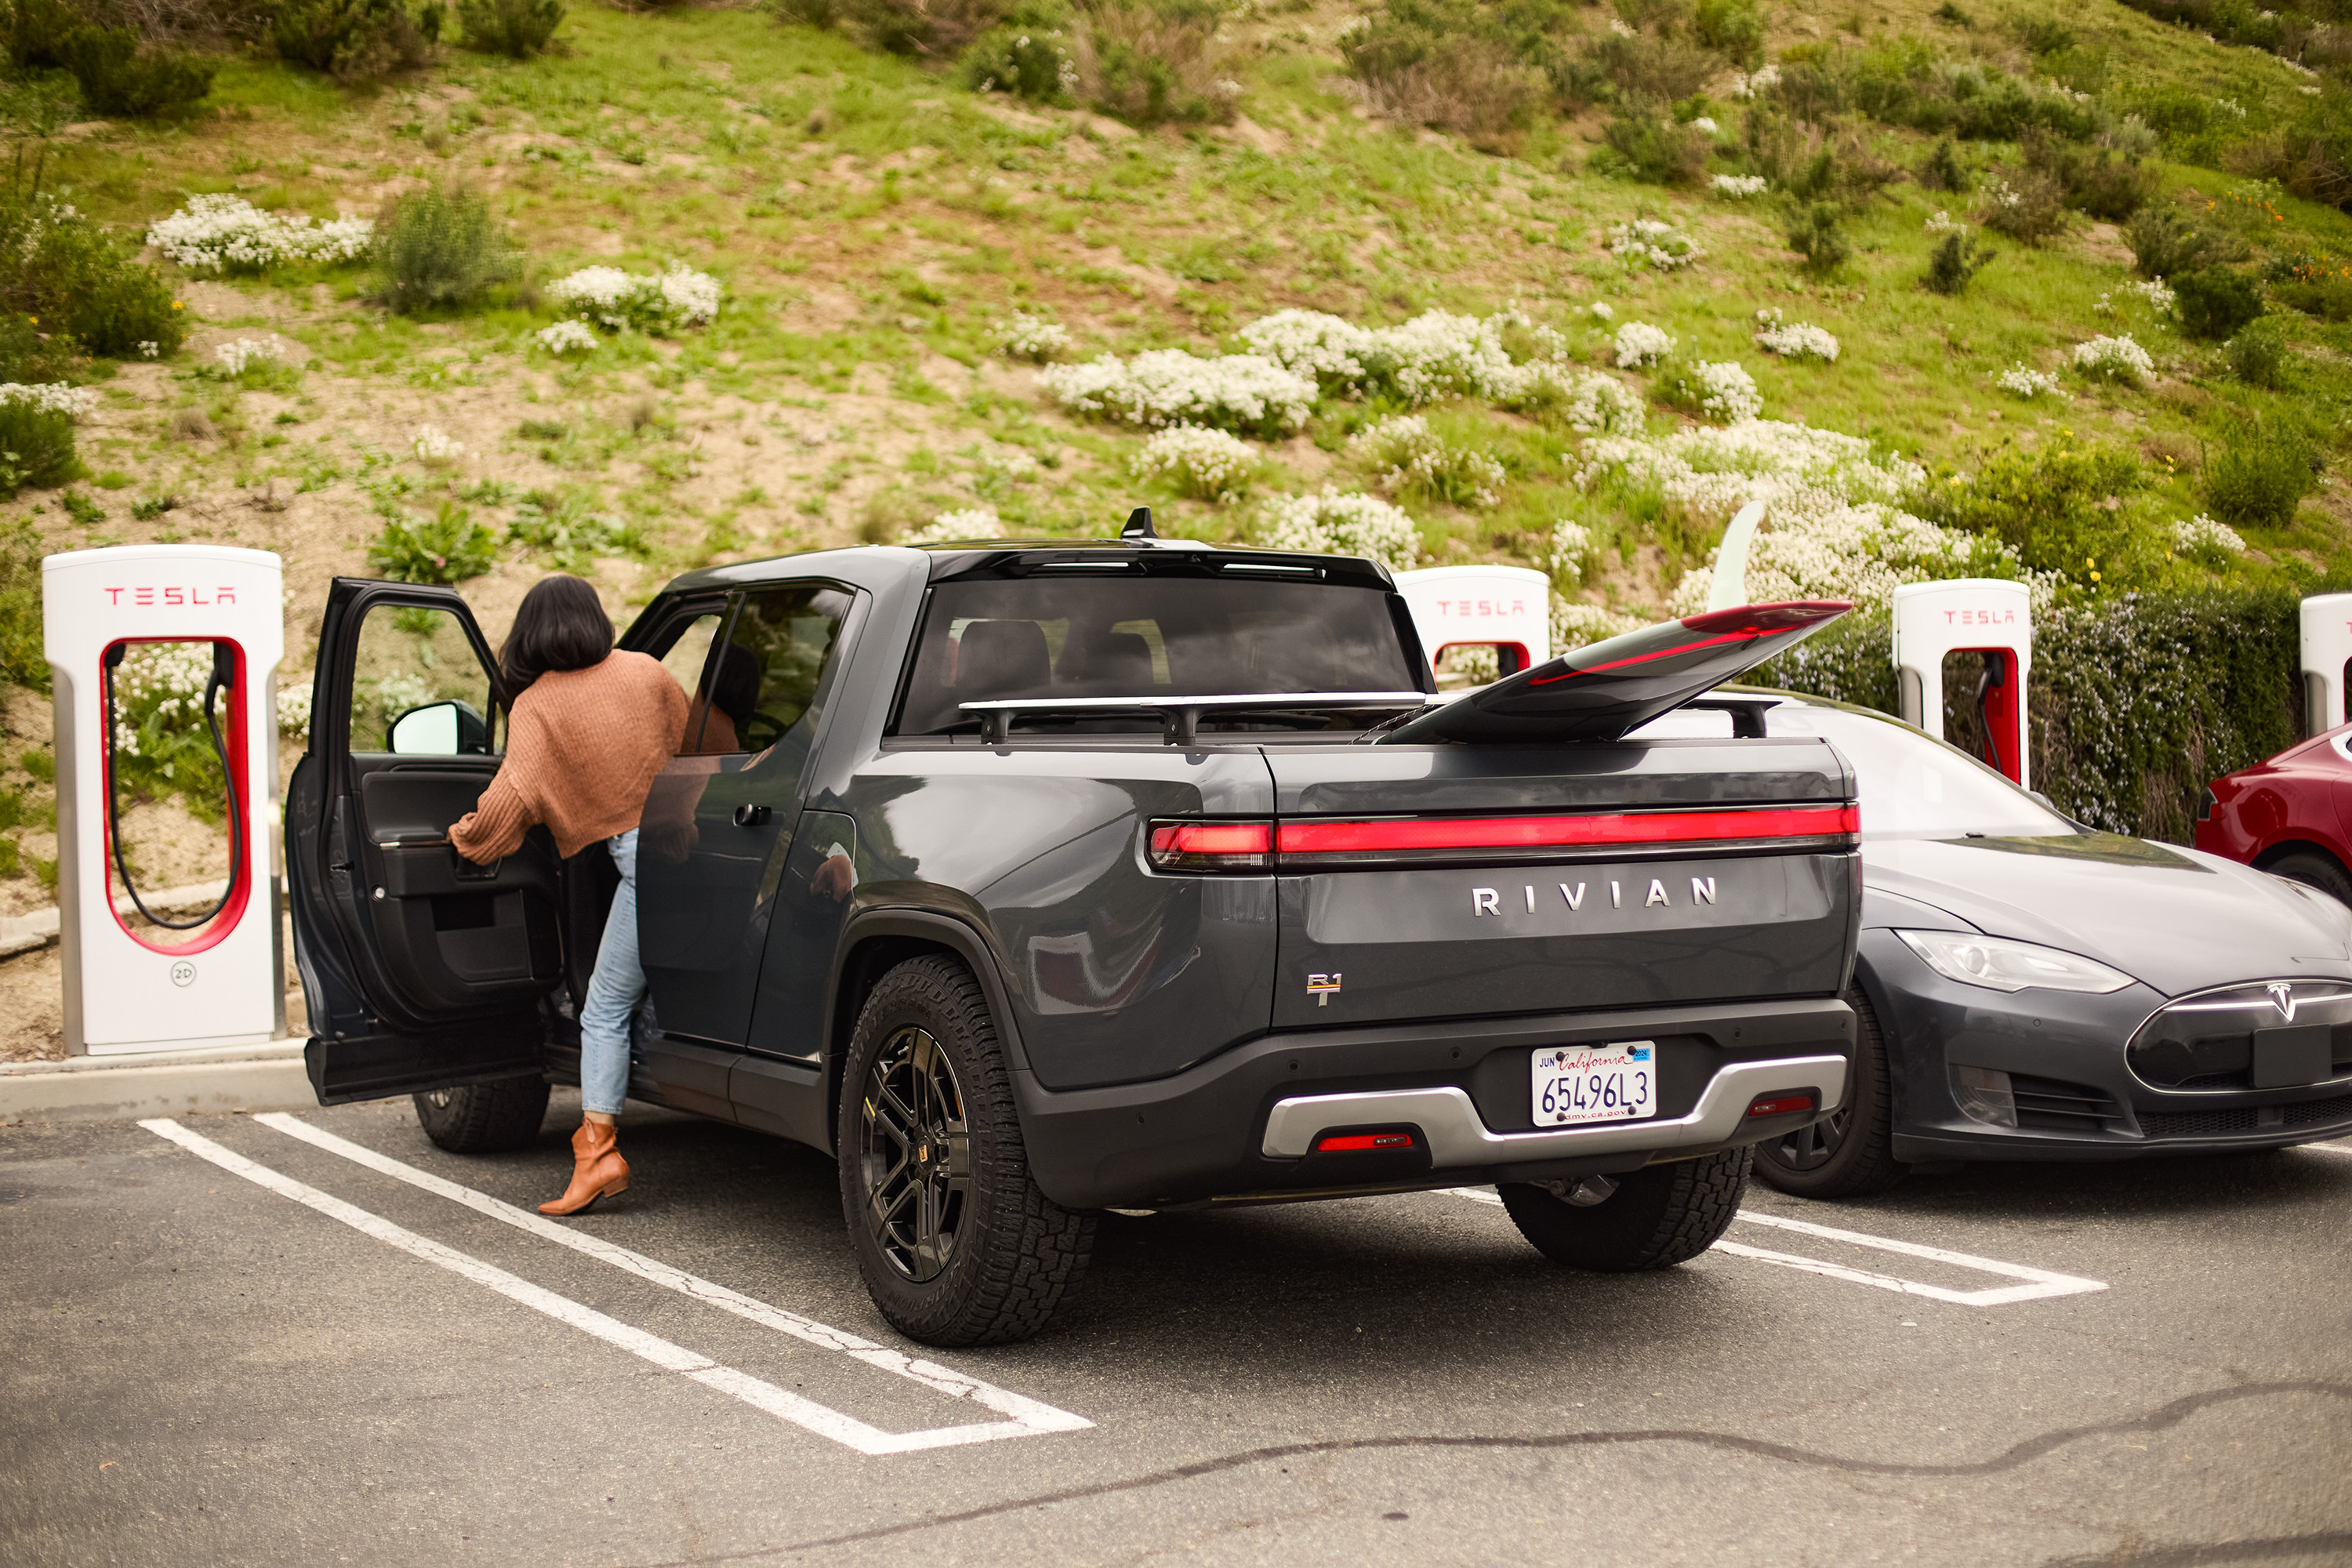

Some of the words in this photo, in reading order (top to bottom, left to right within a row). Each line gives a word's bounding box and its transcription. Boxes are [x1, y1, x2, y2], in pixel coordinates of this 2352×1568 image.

[103, 587, 235, 605] TESLA
[1436, 601, 1525, 615] TESLA
[1944, 610, 2015, 624] TESLA
[1472, 877, 1716, 916] RIVIAN
[175, 968, 193, 979] 2D
[1539, 1057, 1555, 1069] JUN
[1559, 1051, 1634, 1074] California
[1542, 1071, 1648, 1114] 65496L3
[1565, 1109, 1628, 1121] dmv.ca.gov
